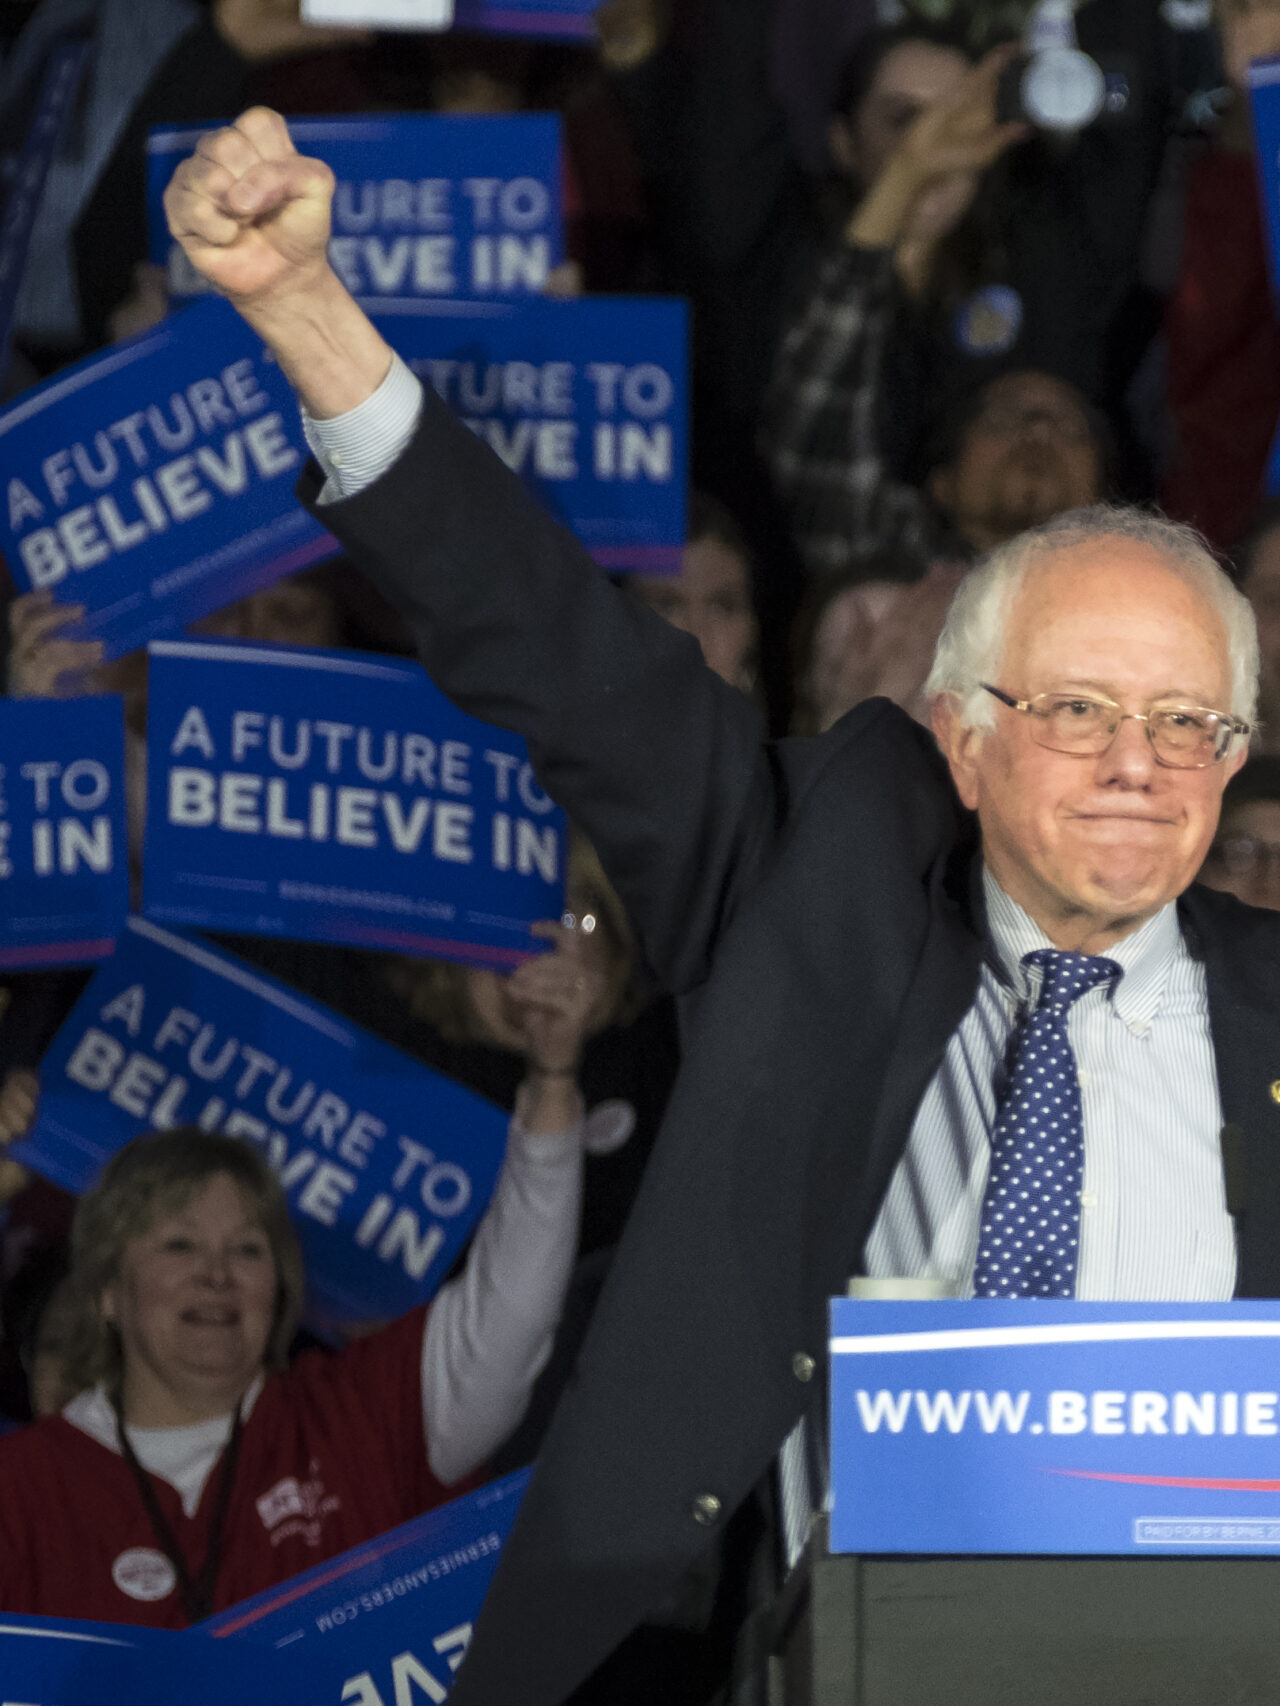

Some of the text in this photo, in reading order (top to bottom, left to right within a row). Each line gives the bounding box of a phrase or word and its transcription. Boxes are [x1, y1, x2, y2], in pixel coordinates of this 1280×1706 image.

[465, 177, 548, 230] TO
[473, 234, 549, 292] IN
[586, 362, 674, 417] TO
[7, 358, 268, 532] A FUTURE
[594, 421, 671, 482] IN
[19, 411, 299, 592] BELIEVE
[20, 759, 110, 813] TO
[172, 705, 213, 760] A
[232, 710, 472, 797] FUTURE
[32, 815, 112, 877] IN
[168, 765, 559, 885] BELIEVE IN
[102, 984, 472, 1218] A FUTURE TO
[356, 1192, 446, 1280] IN
[316, 1531, 500, 1633] BERNIESANDERS.COM
